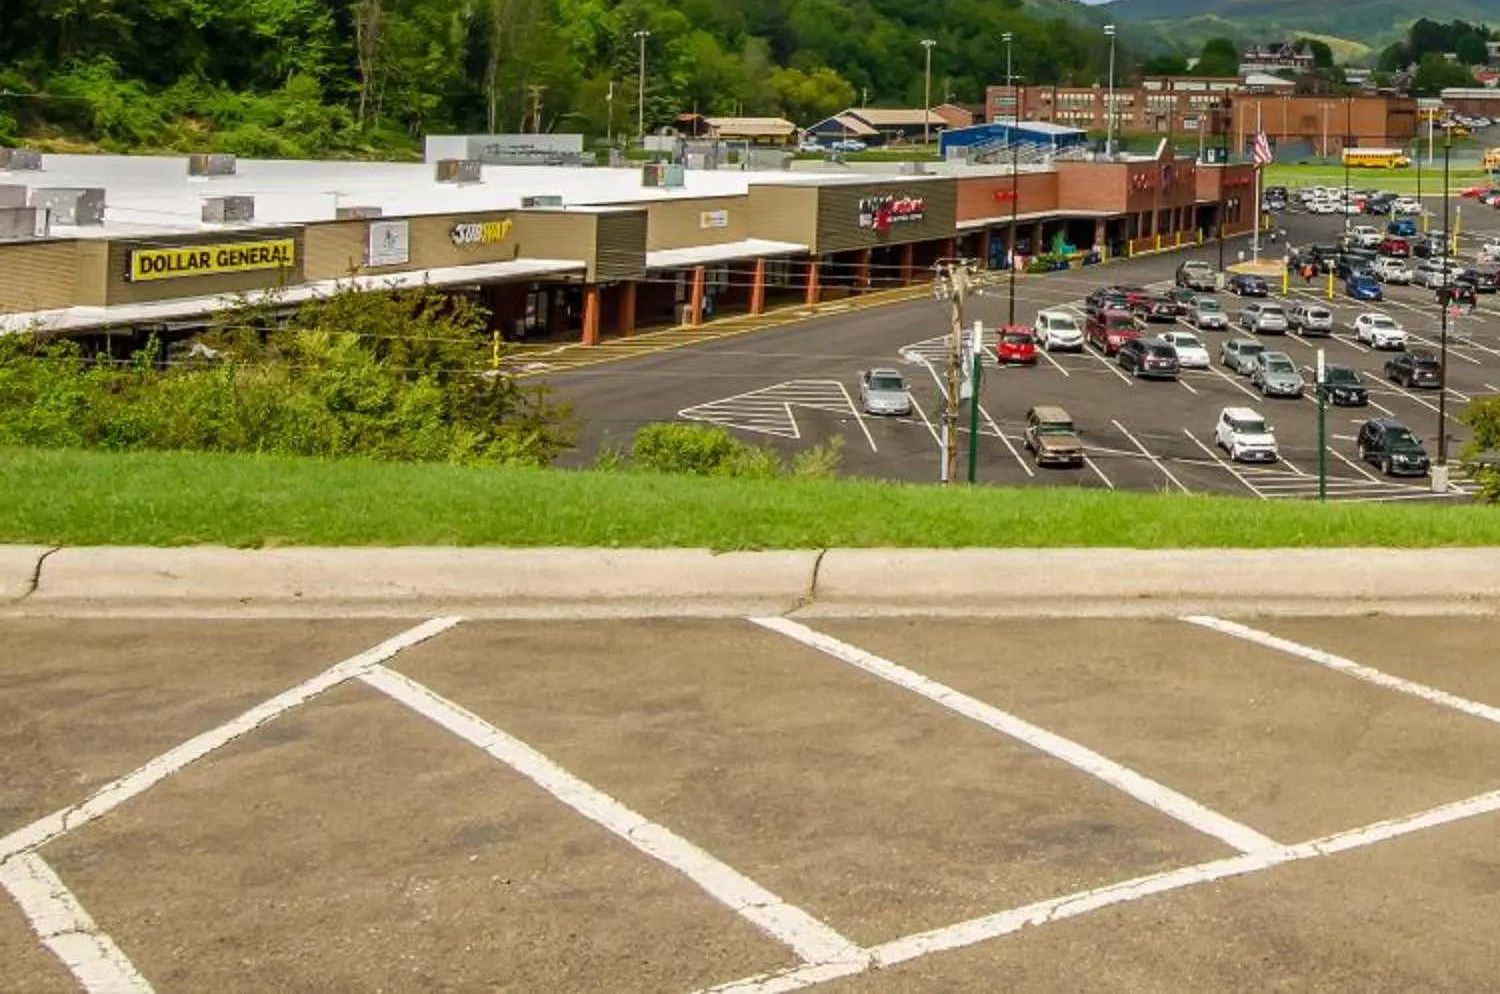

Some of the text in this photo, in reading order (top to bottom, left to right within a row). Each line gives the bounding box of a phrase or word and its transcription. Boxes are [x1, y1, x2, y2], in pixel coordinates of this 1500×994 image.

[450, 218, 513, 245] SUBWAY
[140, 245, 290, 274] DOLLAR GENERAL
